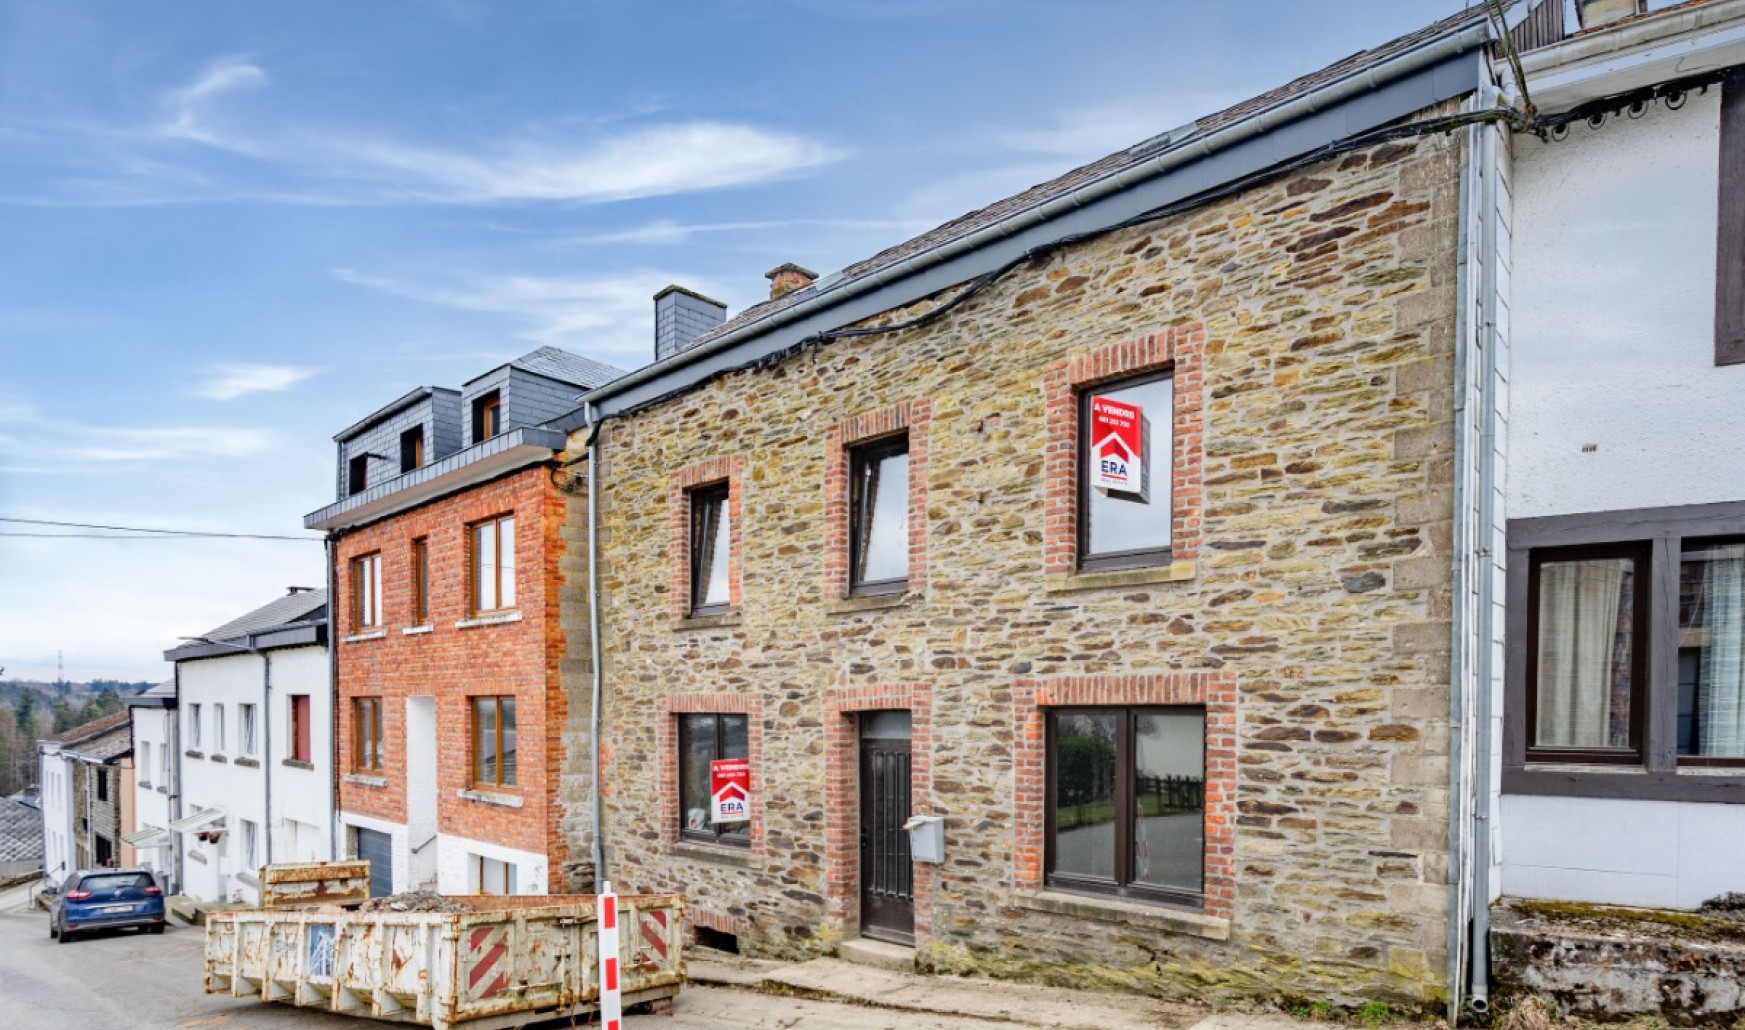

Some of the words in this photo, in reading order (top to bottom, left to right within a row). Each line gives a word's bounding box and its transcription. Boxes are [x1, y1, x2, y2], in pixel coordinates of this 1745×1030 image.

[1094, 403, 1101, 411] A
[1102, 404, 1135, 419] VENDRE
[1101, 460, 1128, 476] ERA
[720, 802, 744, 812] ERA
